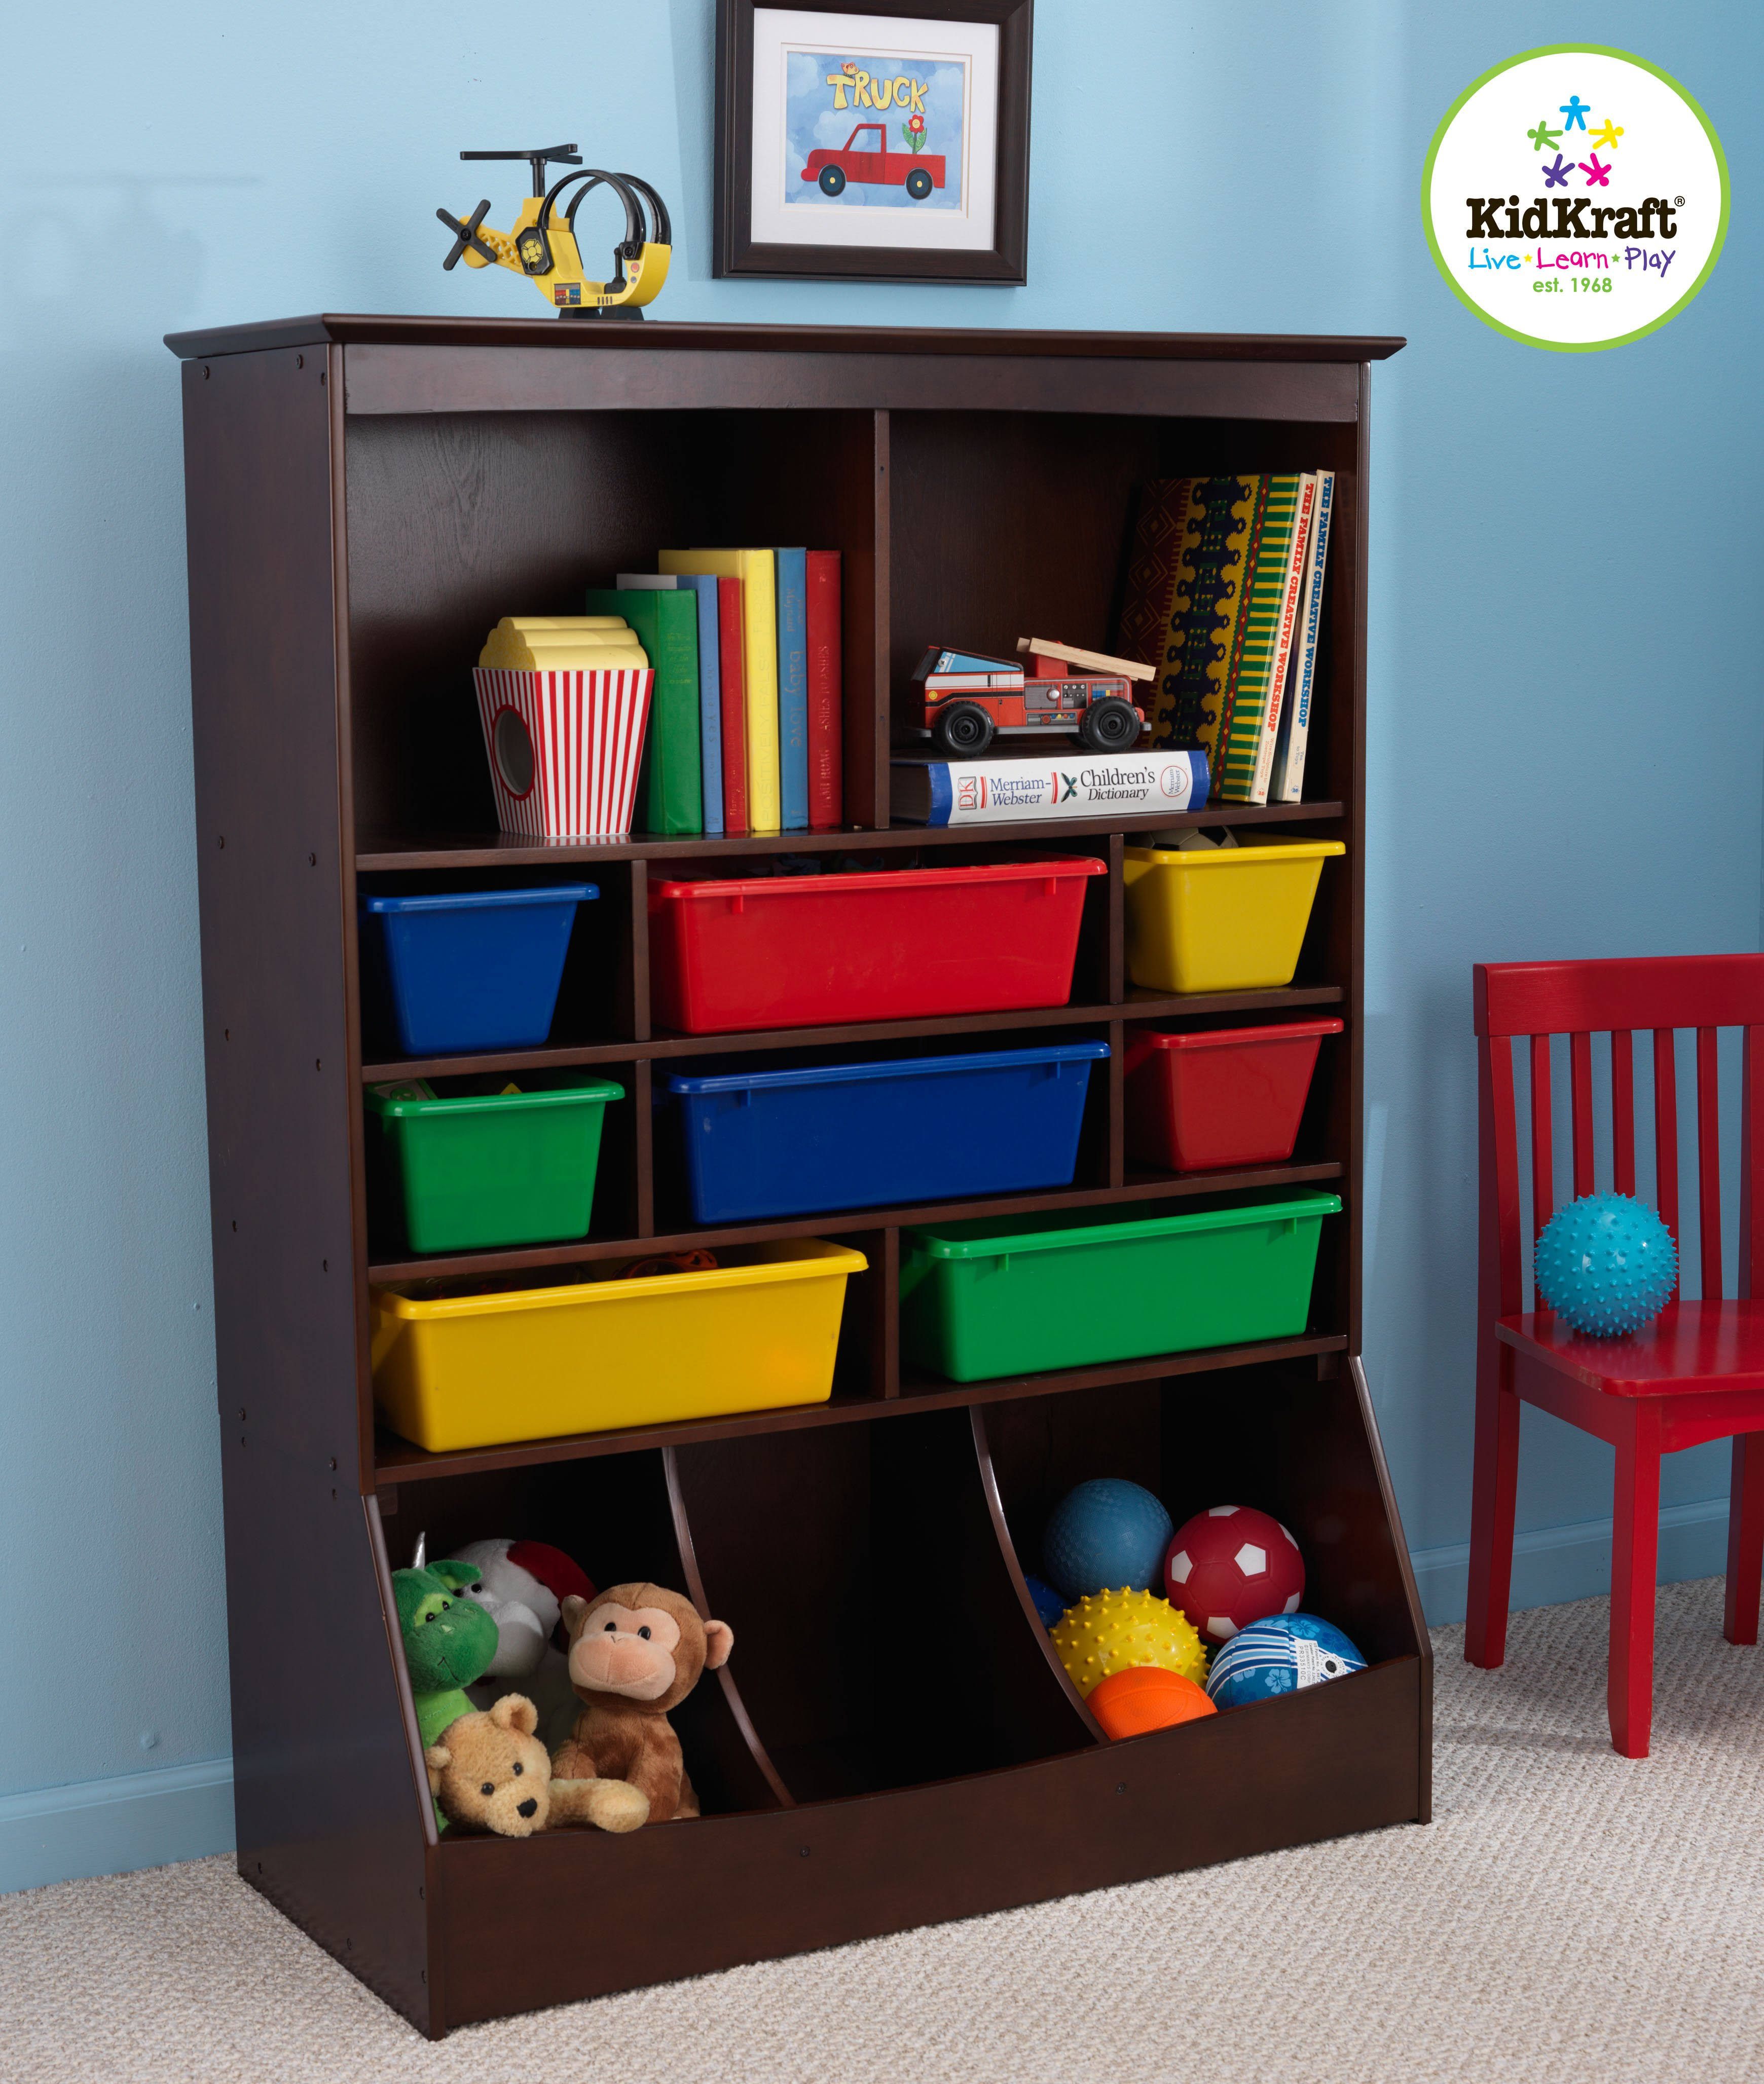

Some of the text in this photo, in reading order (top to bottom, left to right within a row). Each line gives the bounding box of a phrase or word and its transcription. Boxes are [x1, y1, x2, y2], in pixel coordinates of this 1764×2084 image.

[827, 71, 928, 113] TRUCK
[1267, 483, 1314, 732] THE FAMILY CREATIVE WORKSHOP
[1298, 476, 1333, 727] THE FAMILY CREATIVE WORKSHOP
[785, 651, 805, 747] baby love
[819, 698, 831, 731] ASHES
[706, 713, 717, 742] yes
[757, 647, 773, 821] POSITIVELY FALSE
[989, 776, 1051, 792] Merriam-
[1081, 766, 1155, 787] Children's
[959, 780, 974, 807] DK
[992, 791, 1042, 806] Webster
[1088, 788, 1149, 800] Dictionary
[1298, 1646, 1306, 1680] PR33510C
